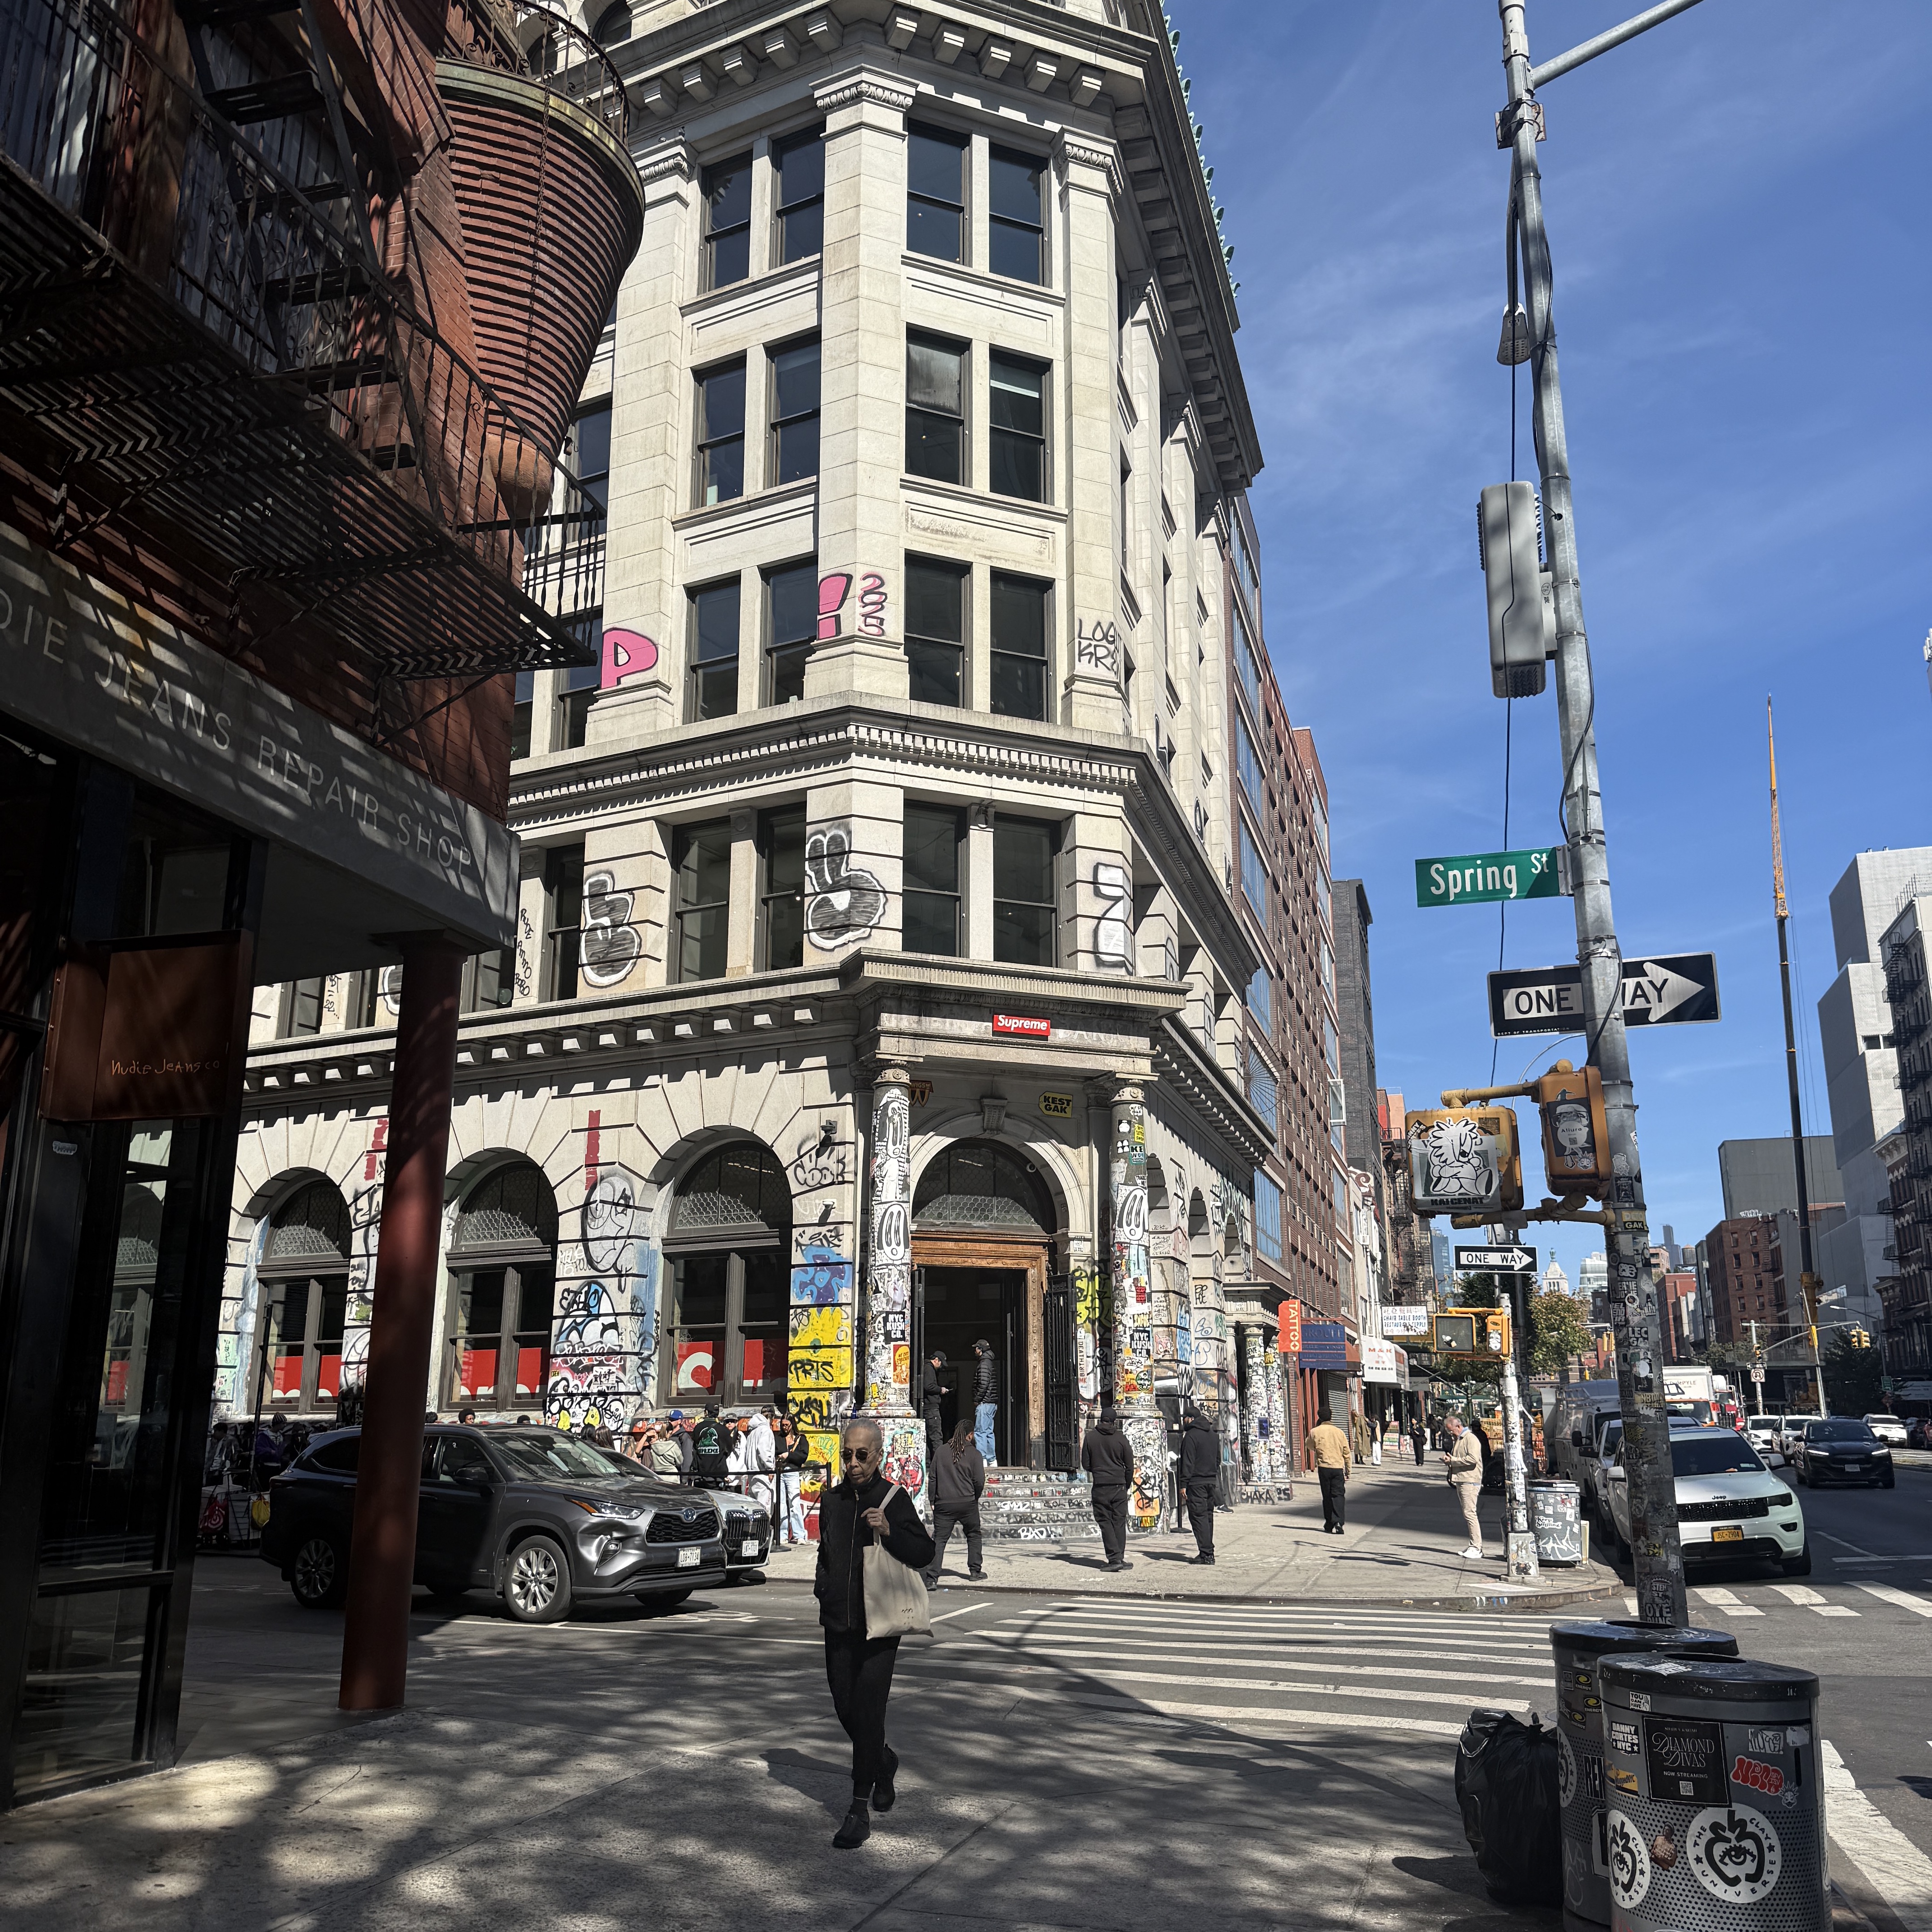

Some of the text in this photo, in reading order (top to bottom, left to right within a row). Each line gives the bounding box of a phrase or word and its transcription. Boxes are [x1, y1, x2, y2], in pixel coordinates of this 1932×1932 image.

[95, 651, 232, 751] JEANS
[258, 735, 380, 831] REPAIR
[396, 814, 472, 878] SHOP
[1430, 853, 1549, 901] Spring St
[1514, 977, 1670, 1015] ONE AY
[997, 1015, 1048, 1031] Supreme
[111, 1060, 152, 1076] Nudie
[1043, 1095, 1072, 1107] KEST
[1044, 1103, 1069, 1115] GAK
[1466, 1253, 1524, 1263] ONE WAY
[888, 1314, 904, 1322] NYC
[1288, 1301, 1300, 1351] TATTOO
[1133, 1332, 1149, 1341] NYC
[1611, 1730, 1638, 1744] CORTES
[1612, 1722, 1635, 1734] DANNY
[1617, 1741, 1631, 1751] NYC
[1652, 1732, 1715, 1753] DIAMOND
[1663, 1747, 1706, 1767] DIVAS
[1693, 1825, 1707, 1848] THE
[1749, 1817, 1771, 1841] CLAY
[1631, 1837, 1644, 1865] CLAY
[1701, 1859, 1776, 1897] UNIVERSE
